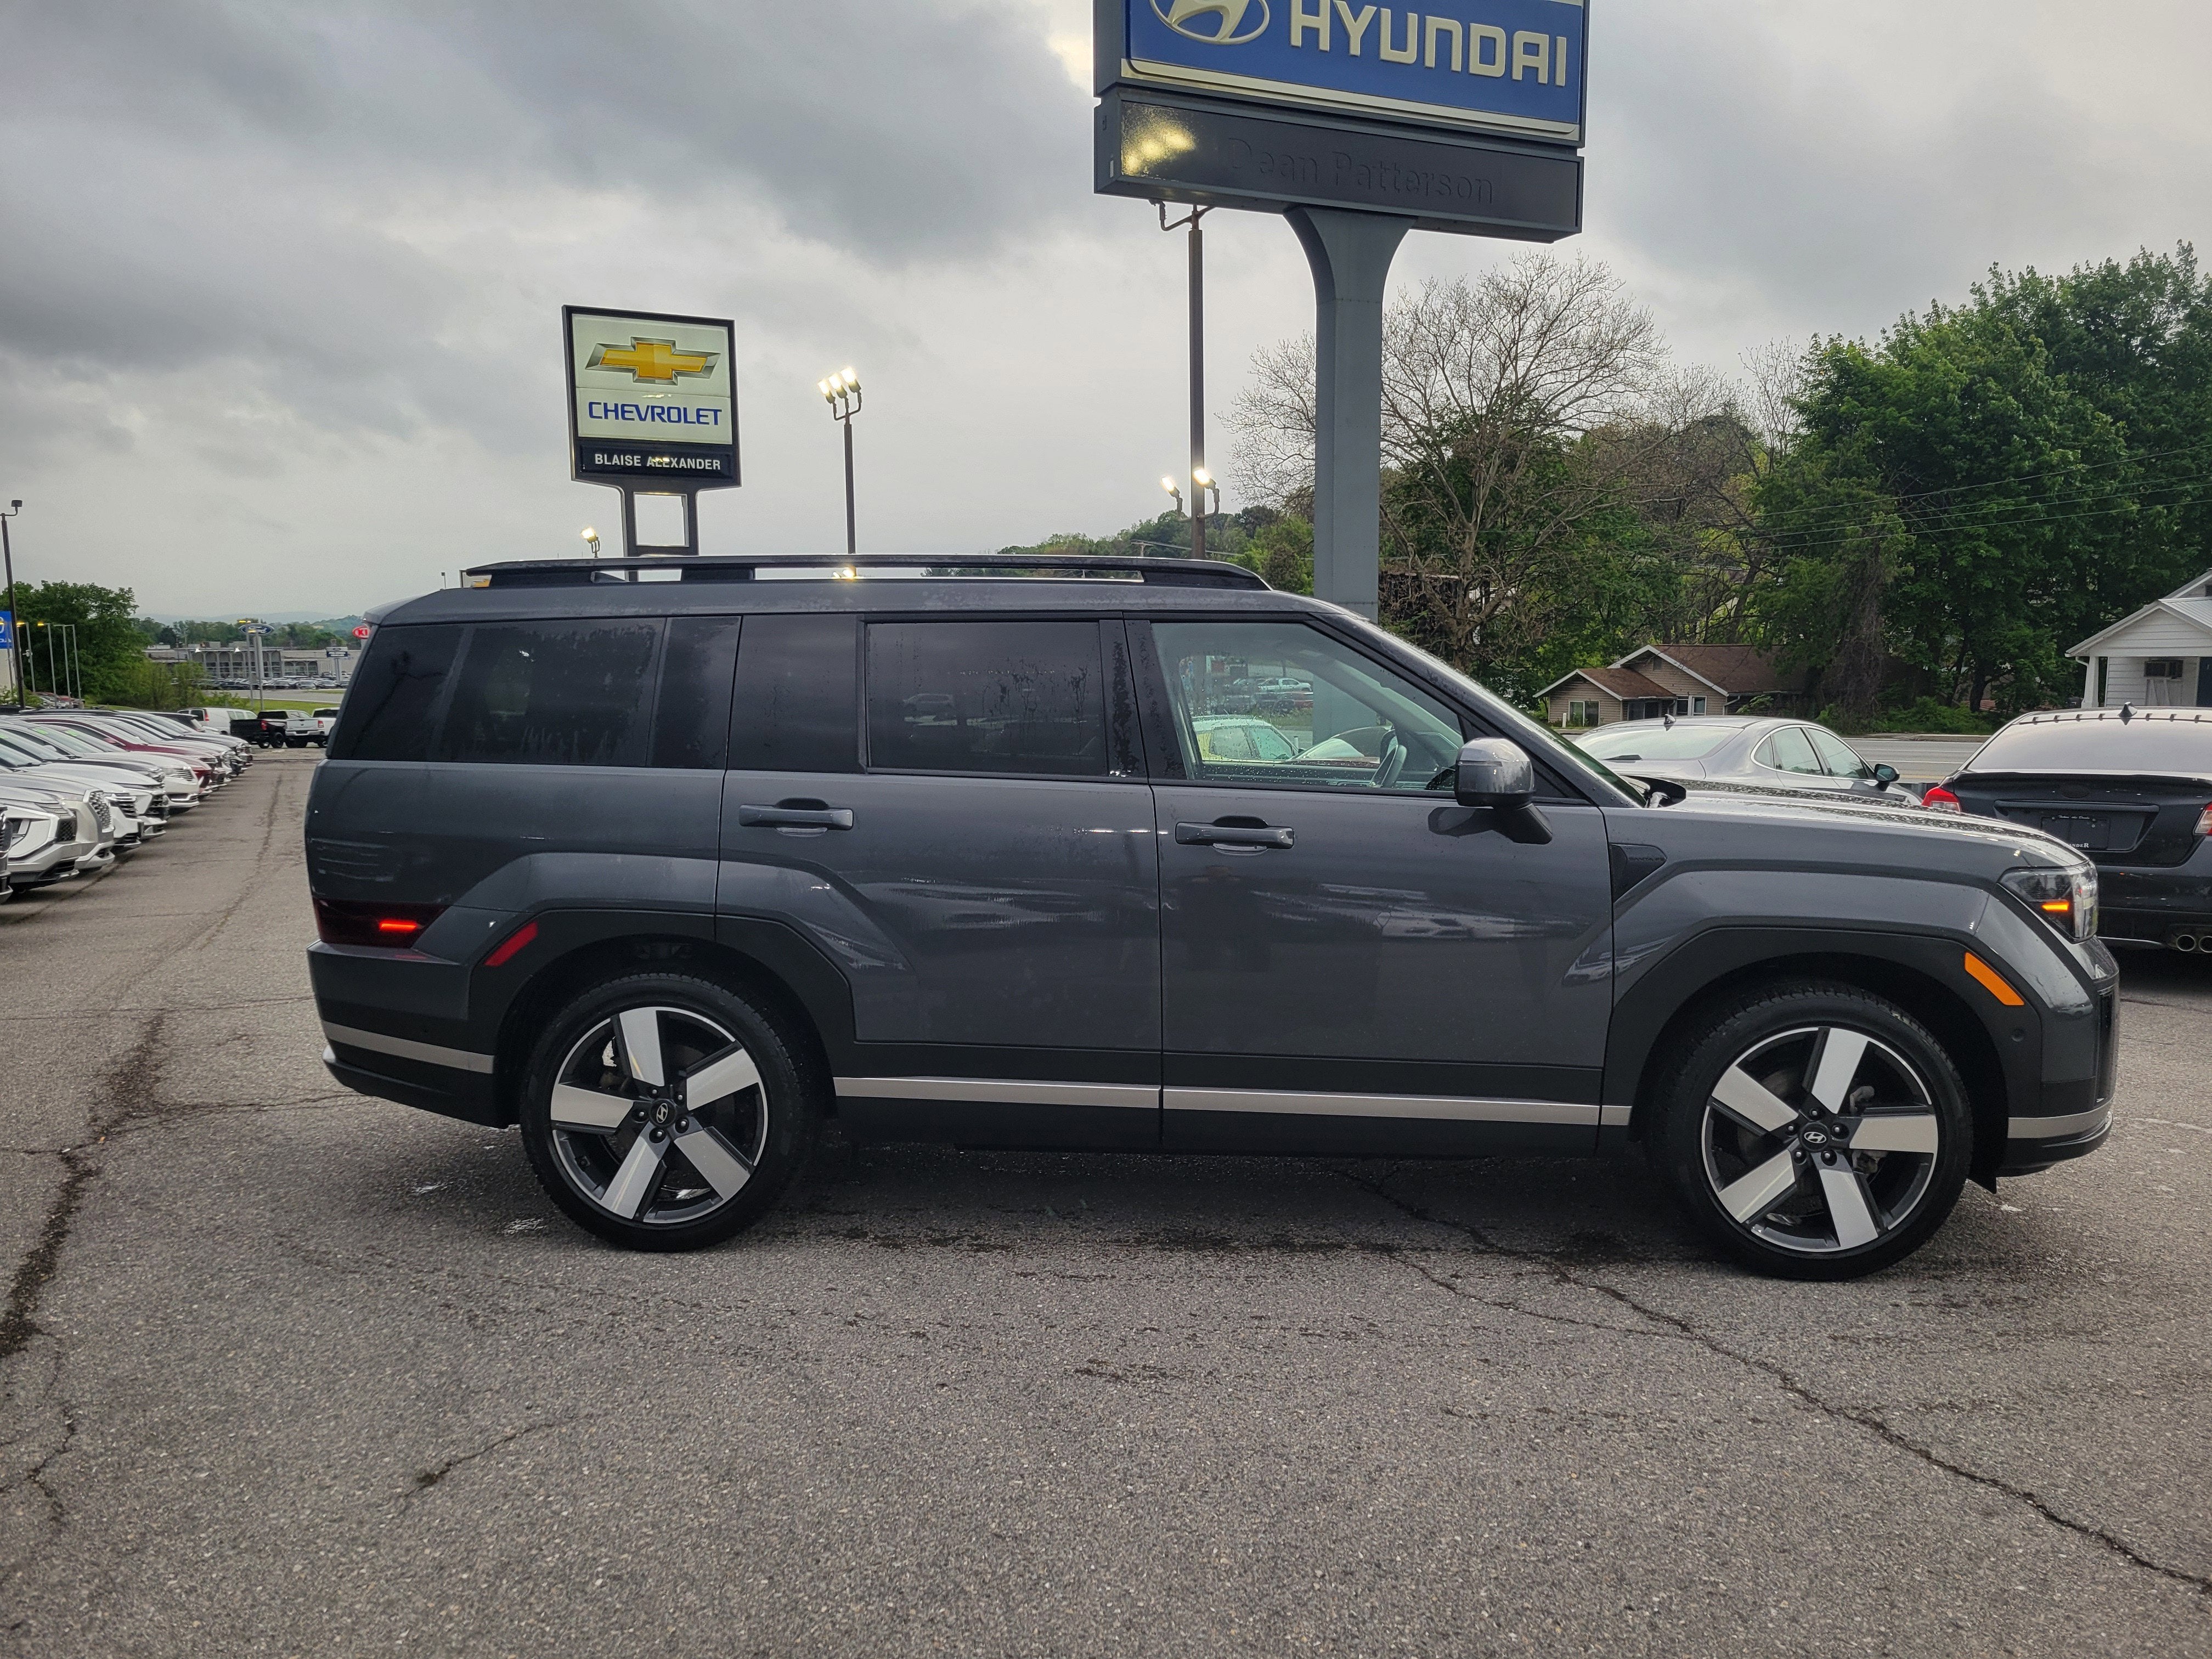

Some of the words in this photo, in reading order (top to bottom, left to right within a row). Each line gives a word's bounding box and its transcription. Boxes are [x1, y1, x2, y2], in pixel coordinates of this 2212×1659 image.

[1290, 0, 1567, 87] HYUNDAI
[1228, 137, 1317, 183] Dean
[1332, 151, 1493, 204] Patterson
[588, 402, 723, 426] CHEVROLET
[595, 454, 641, 466] BLAISE
[646, 456, 721, 470] ALEXANDER
